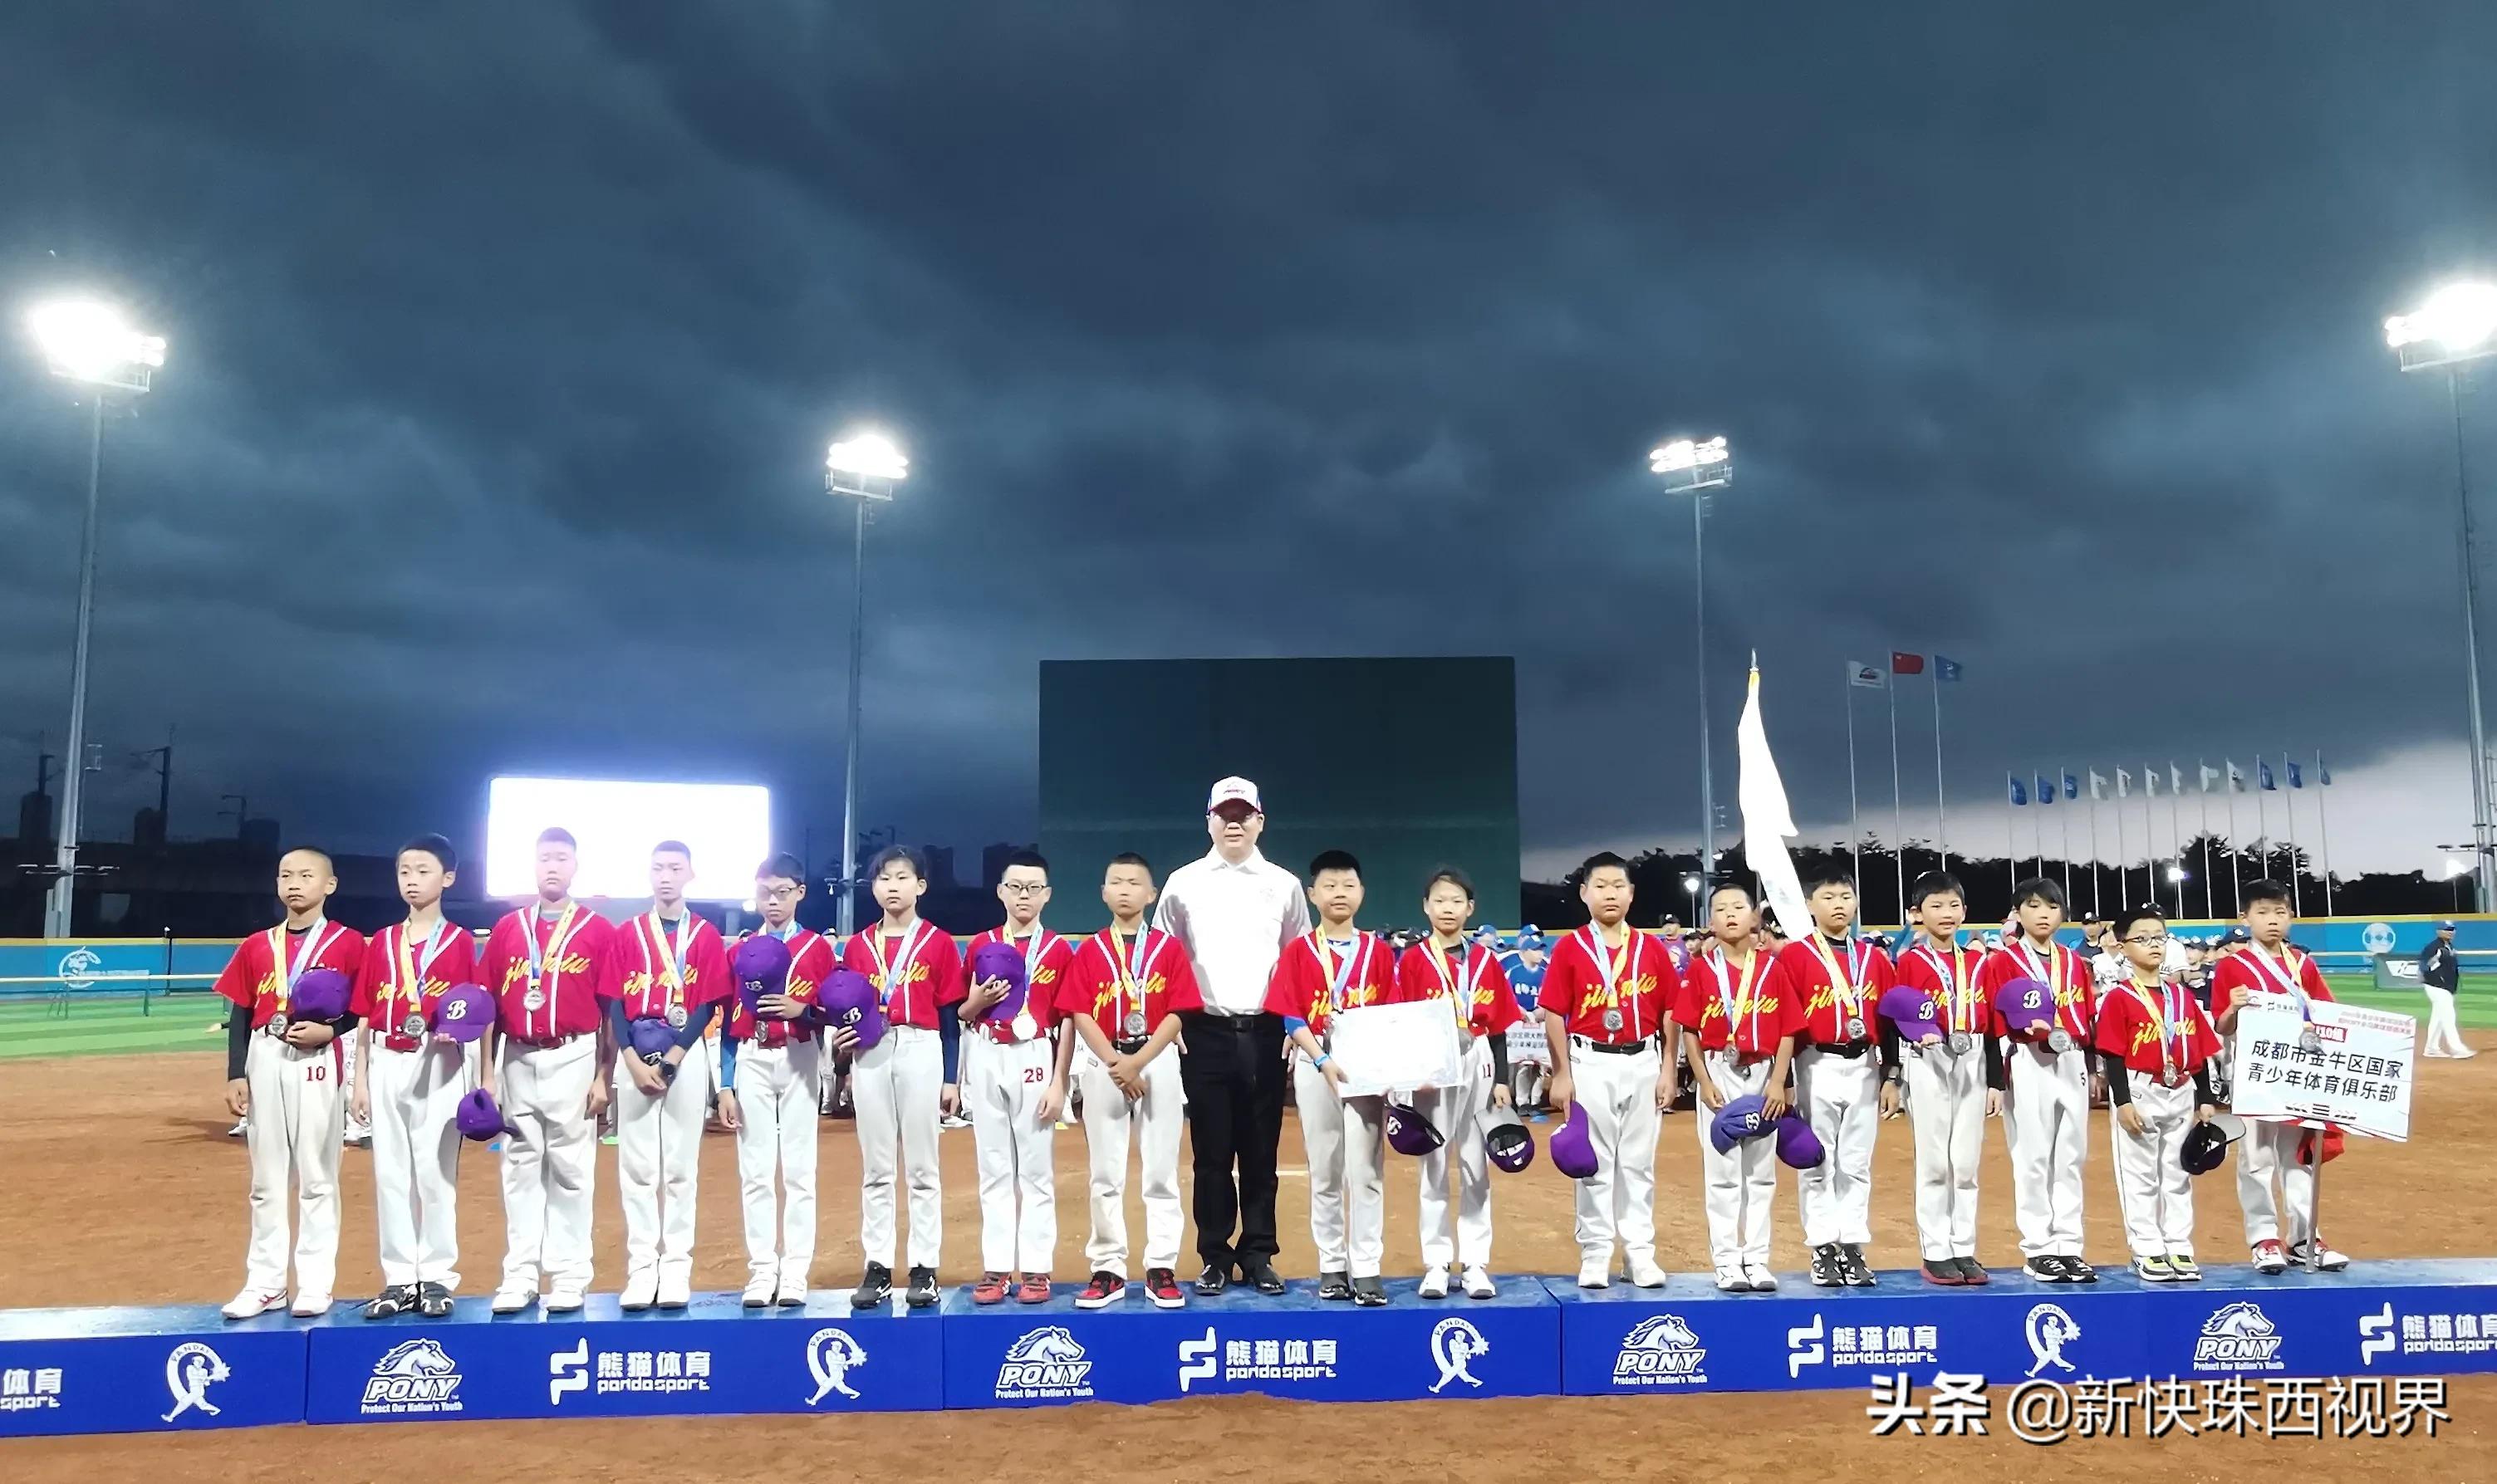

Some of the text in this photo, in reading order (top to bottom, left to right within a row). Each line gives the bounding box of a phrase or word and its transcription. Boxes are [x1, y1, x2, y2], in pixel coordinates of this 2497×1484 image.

[446, 999, 467, 1021] B
[1918, 1001, 1935, 1021] B
[2022, 989, 2042, 1010] B
[2251, 1039, 2403, 1079] 成都市金牛区国家
[306, 1065, 326, 1082] 10
[1023, 1067, 1043, 1084] 28
[2248, 1062, 2398, 1103] 青少年体育俱乐部
[1832, 1325, 1938, 1351] 熊猫体育
[2195, 1337, 2280, 1360] PONY
[2403, 1338, 2497, 1356] pandaspor
[597, 1350, 711, 1378] 熊猫体育
[1225, 1340, 1337, 1366] 熊猫体育
[1615, 1351, 1704, 1374] PONY
[1832, 1349, 1938, 1369] pandasport
[3, 1369, 63, 1395] 体育
[998, 1363, 1090, 1387] PONY
[1225, 1364, 1337, 1383] pandasport
[363, 1376, 460, 1402] PONY
[596, 1376, 711, 1395] pandasport
